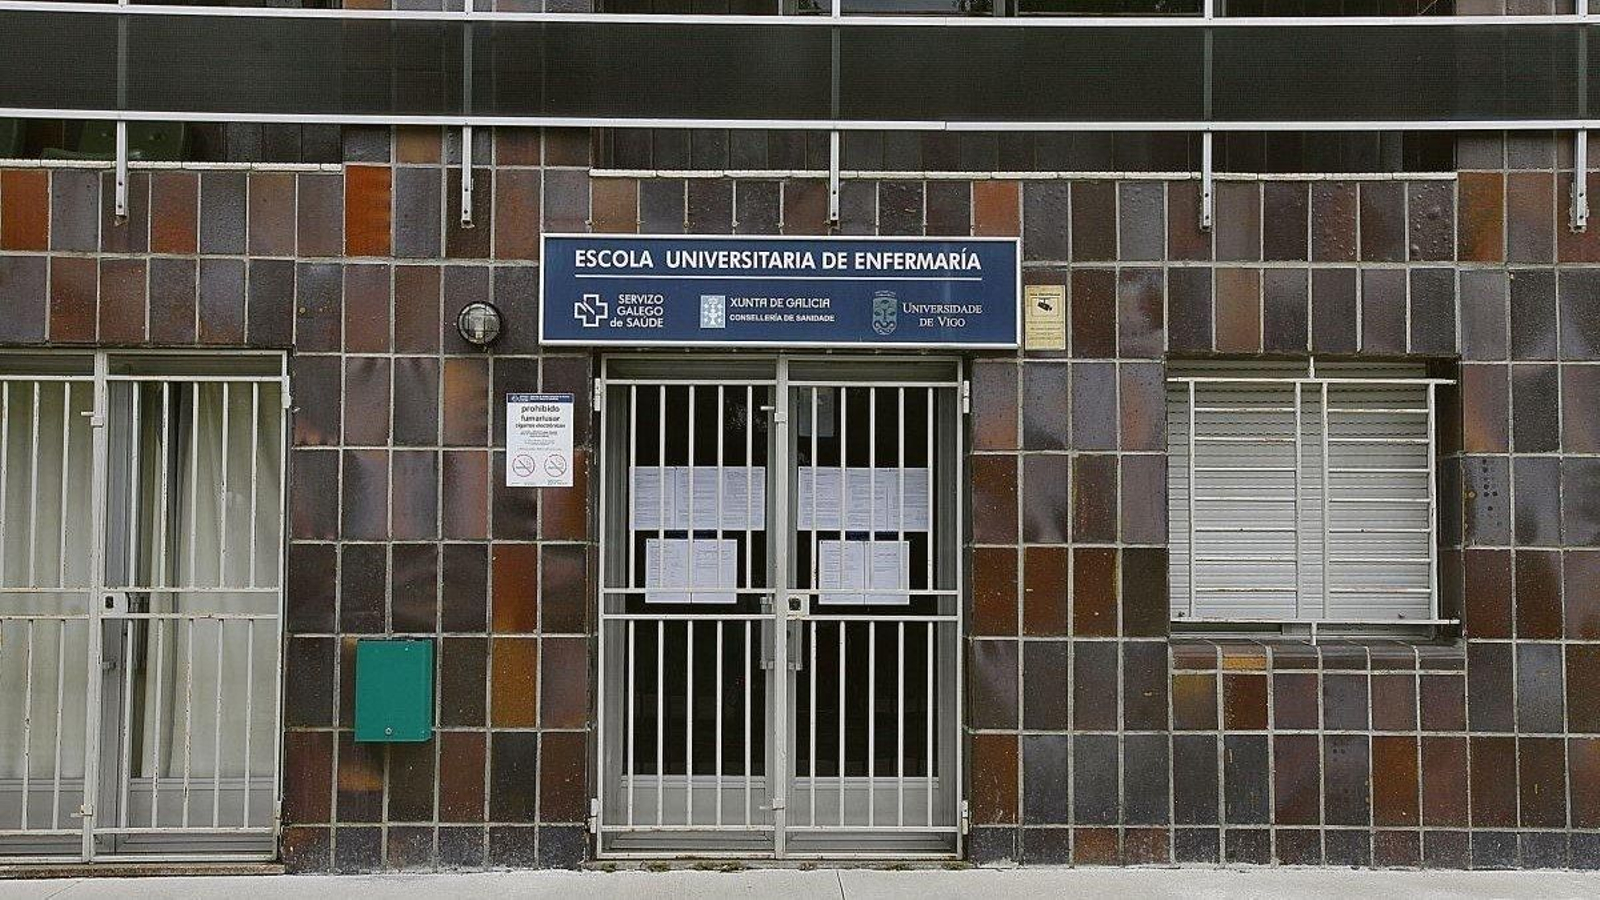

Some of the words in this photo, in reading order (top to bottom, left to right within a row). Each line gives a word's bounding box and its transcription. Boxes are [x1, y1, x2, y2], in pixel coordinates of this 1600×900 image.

[575, 250, 654, 268] ESCOLA
[666, 251, 816, 269] UNIVERSITARIA
[822, 252, 848, 269] DE
[855, 248, 982, 270] ENFERMARÍA
[618, 294, 664, 305] SERVIZO
[729, 297, 768, 309] XUNTA
[770, 298, 785, 309] DE
[786, 298, 831, 309] GALICIA
[616, 306, 664, 317] GALEGO
[902, 302, 983, 314] UNIVERSIDADE
[609, 317, 623, 328] de
[626, 316, 664, 328] SAÚDE
[729, 313, 783, 322] CONSELLERÍA
[783, 314, 795, 322] DE
[795, 314, 837, 322] SANIDADE
[919, 318, 934, 328] DE
[937, 316, 966, 328] VIGO
[521, 405, 560, 413] prohibido
